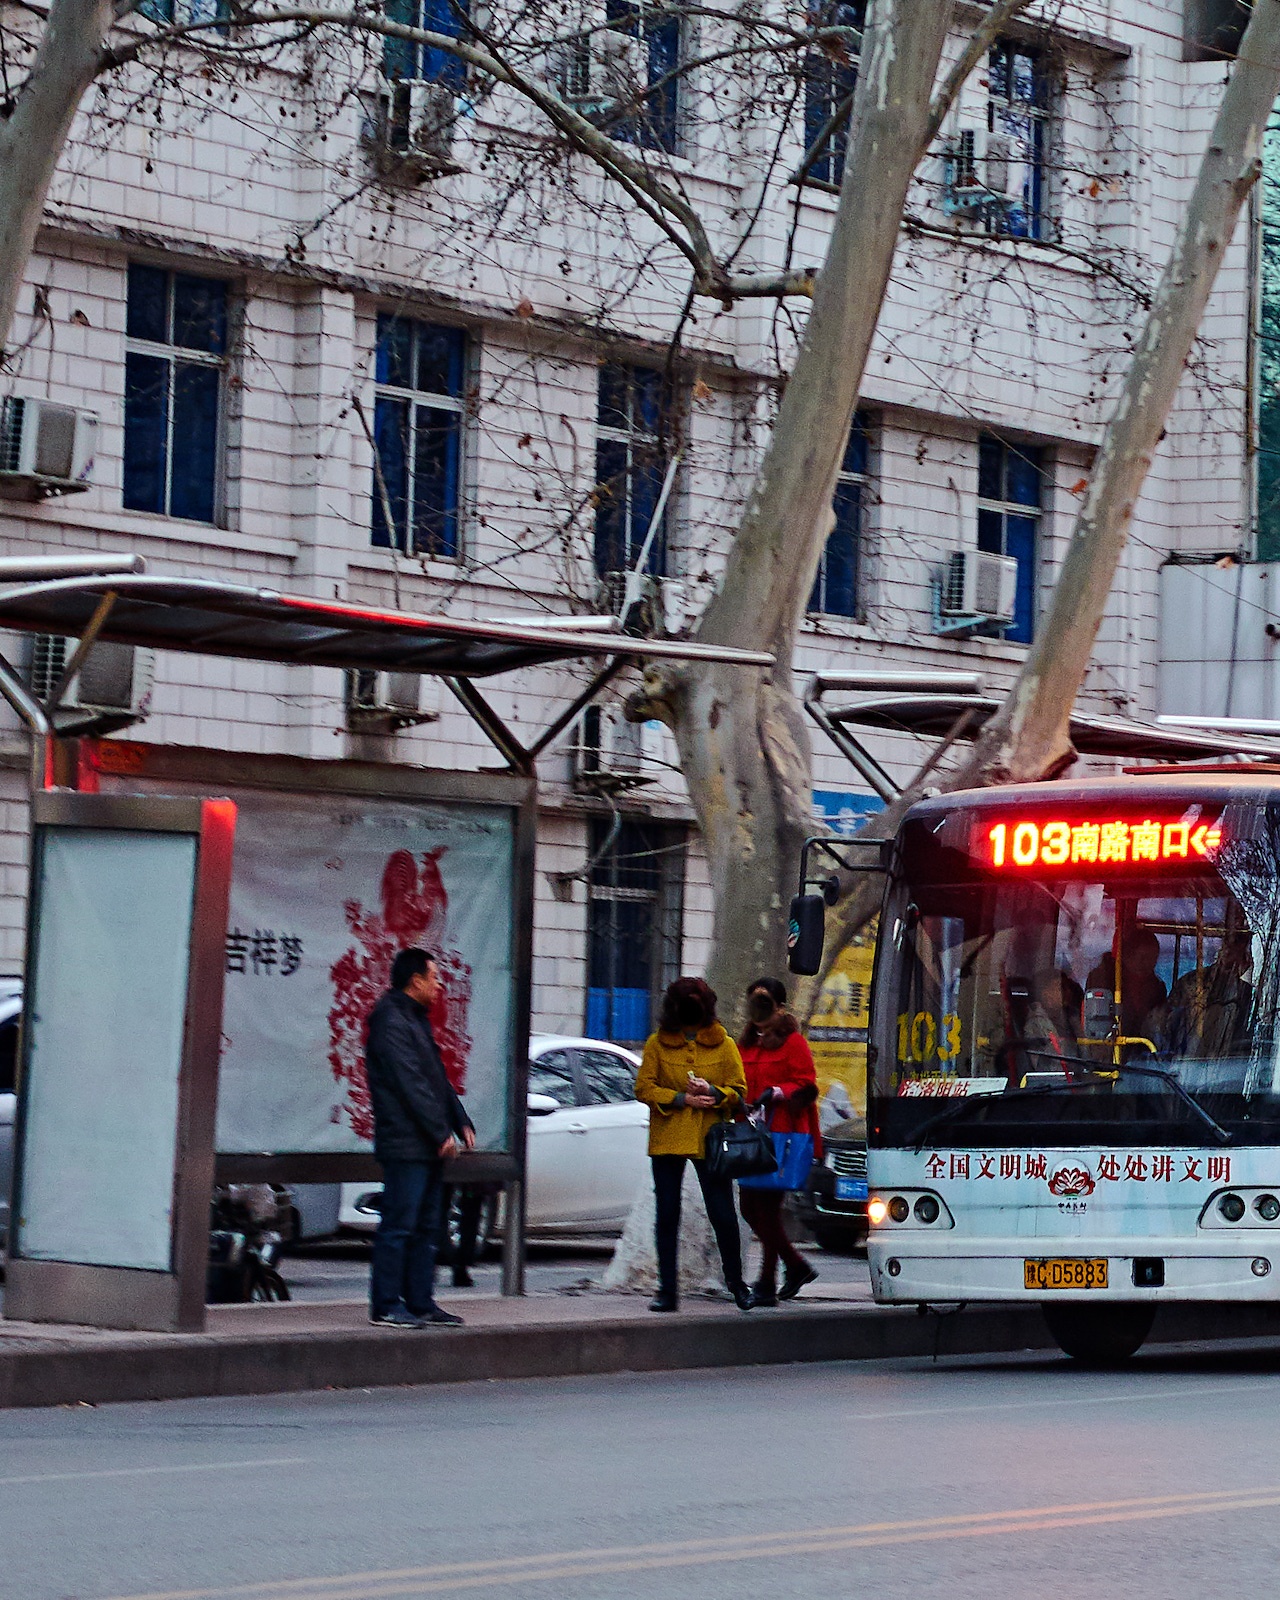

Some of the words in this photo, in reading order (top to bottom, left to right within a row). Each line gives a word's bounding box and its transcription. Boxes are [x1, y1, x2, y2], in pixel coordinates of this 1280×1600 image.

[897, 1010, 963, 1063] 103
[924, 1153, 1048, 1180] 全国文明城
[1096, 1156, 1231, 1183] 处处讲文明
